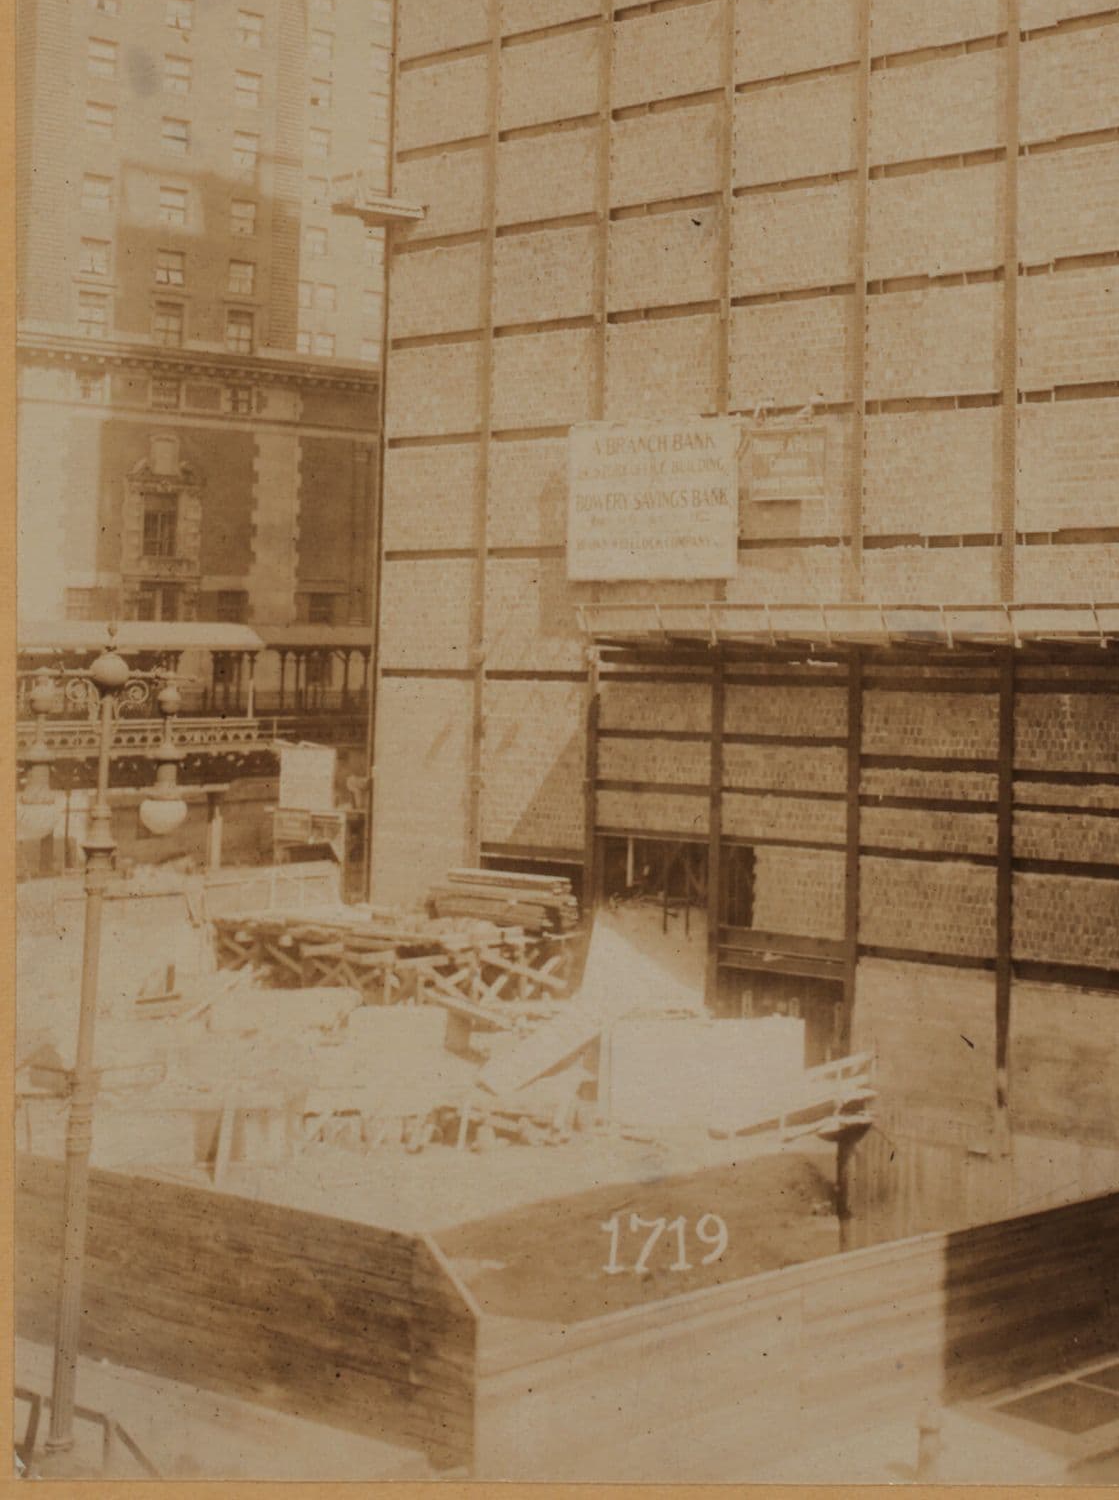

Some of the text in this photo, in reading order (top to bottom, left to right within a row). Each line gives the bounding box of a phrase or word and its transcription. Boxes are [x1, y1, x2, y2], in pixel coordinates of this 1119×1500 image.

[606, 432, 669, 456] BRANCH
[671, 430, 717, 452] BANK
[632, 489, 688, 511] SAVINGS
[690, 487, 730, 509] BANK
